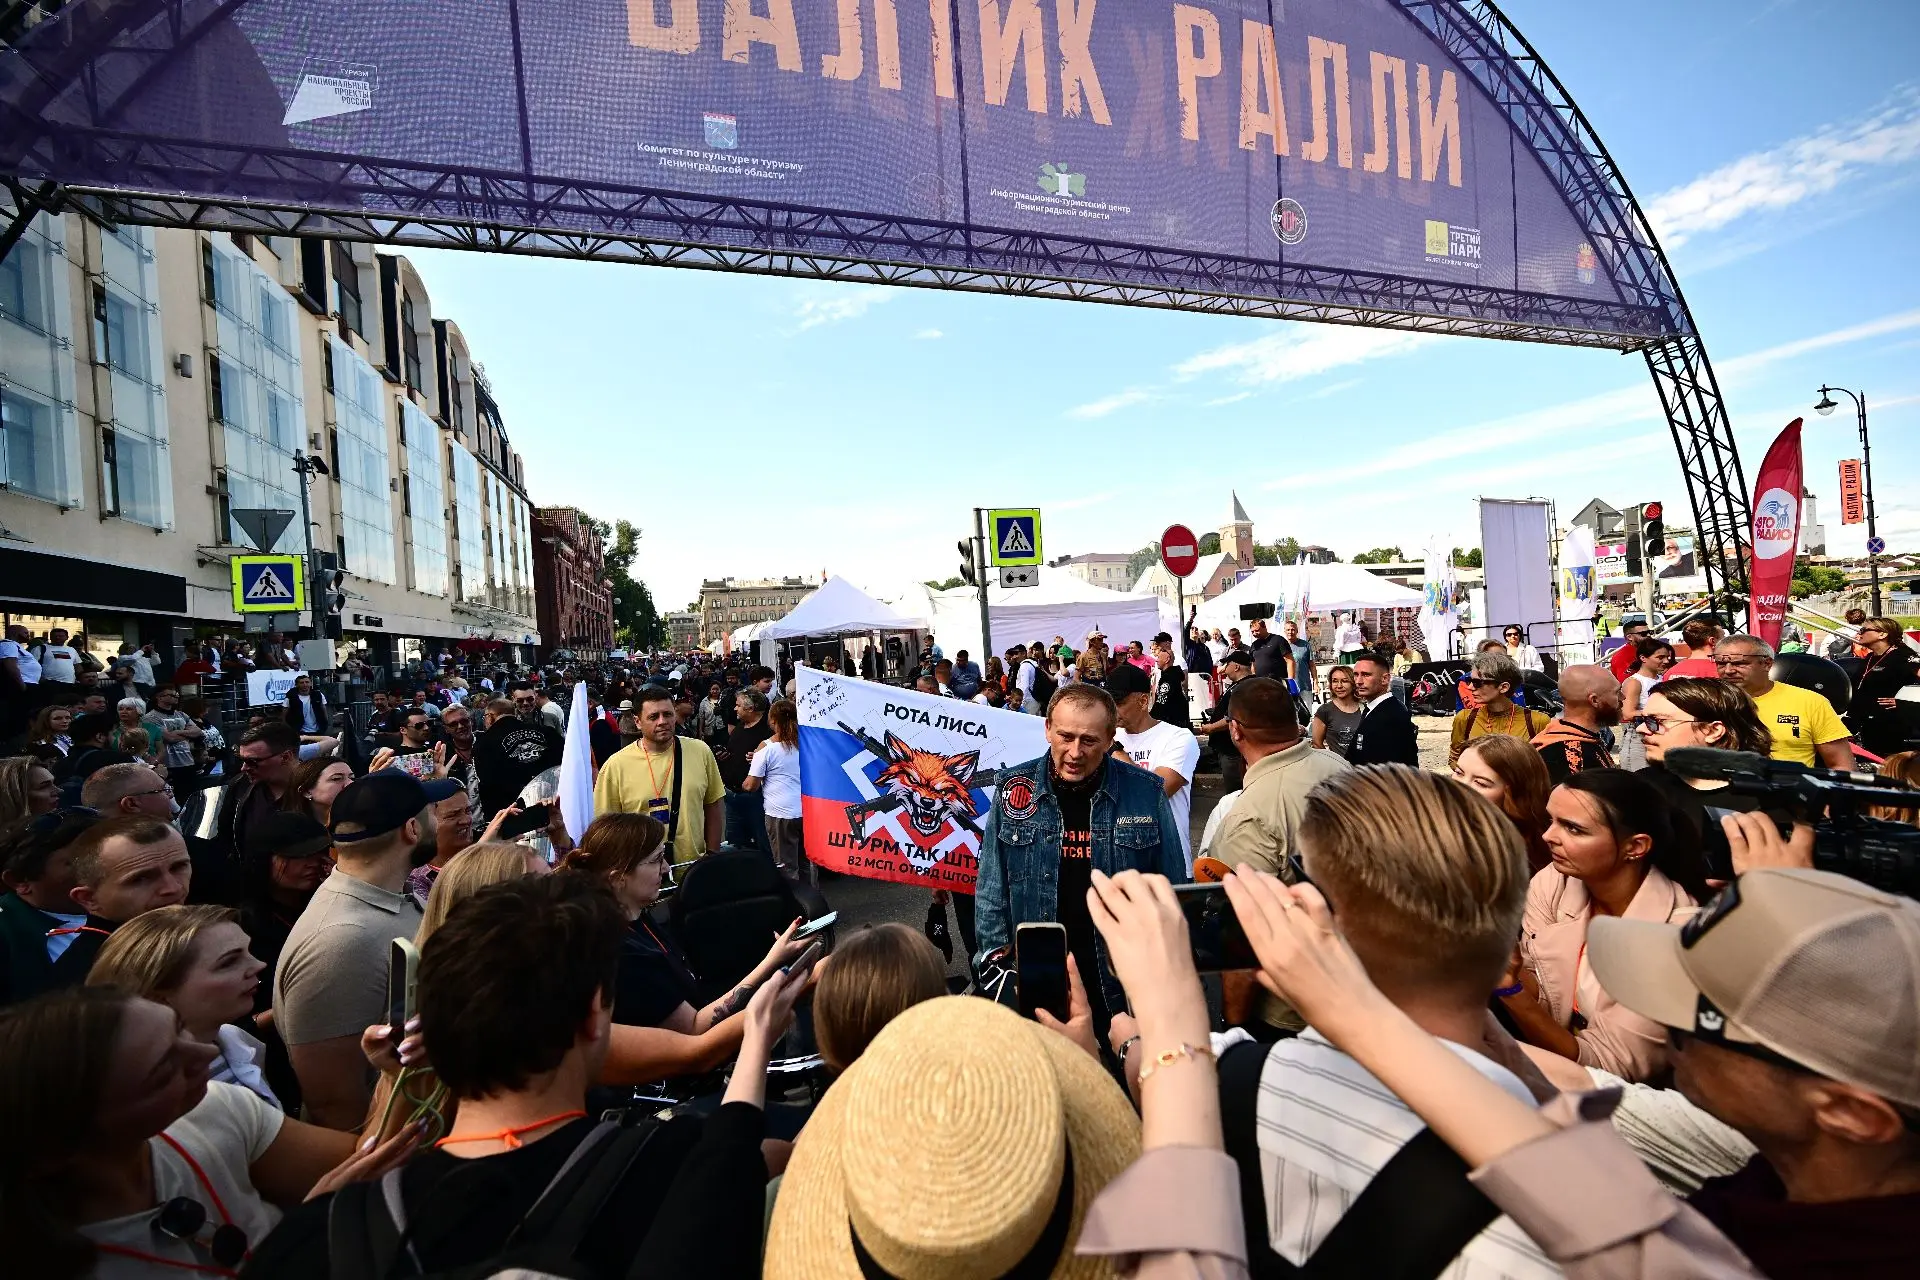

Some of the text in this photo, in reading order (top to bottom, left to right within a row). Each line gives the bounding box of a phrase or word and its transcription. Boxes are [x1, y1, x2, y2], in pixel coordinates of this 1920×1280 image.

[307, 76, 369, 91] НАЦИОНАЛЬНЫЕ
[334, 87, 370, 99] ПРОЕКТЫ
[341, 96, 371, 107] РОССИИ
[1173, 3, 1463, 188] РАЛЛИ
[636, 142, 804, 173] Комитет по культуре и туризму
[658, 156, 785, 180] Ленинградской области
[1014, 201, 1110, 221] Ленинградской области
[1108, 205, 1131, 214] центр
[1449, 231, 1481, 245] ТРЕТИЙ
[1450, 241, 1481, 259] ПАРК
[1757, 594, 1786, 605] АДИ
[883, 702, 988, 739] РОТА ЛИСА
[828, 831, 900, 856] ШТУРМ
[904, 842, 940, 863] ТАК
[847, 855, 862, 867] 82
[898, 862, 940, 881] ОТРЯД
